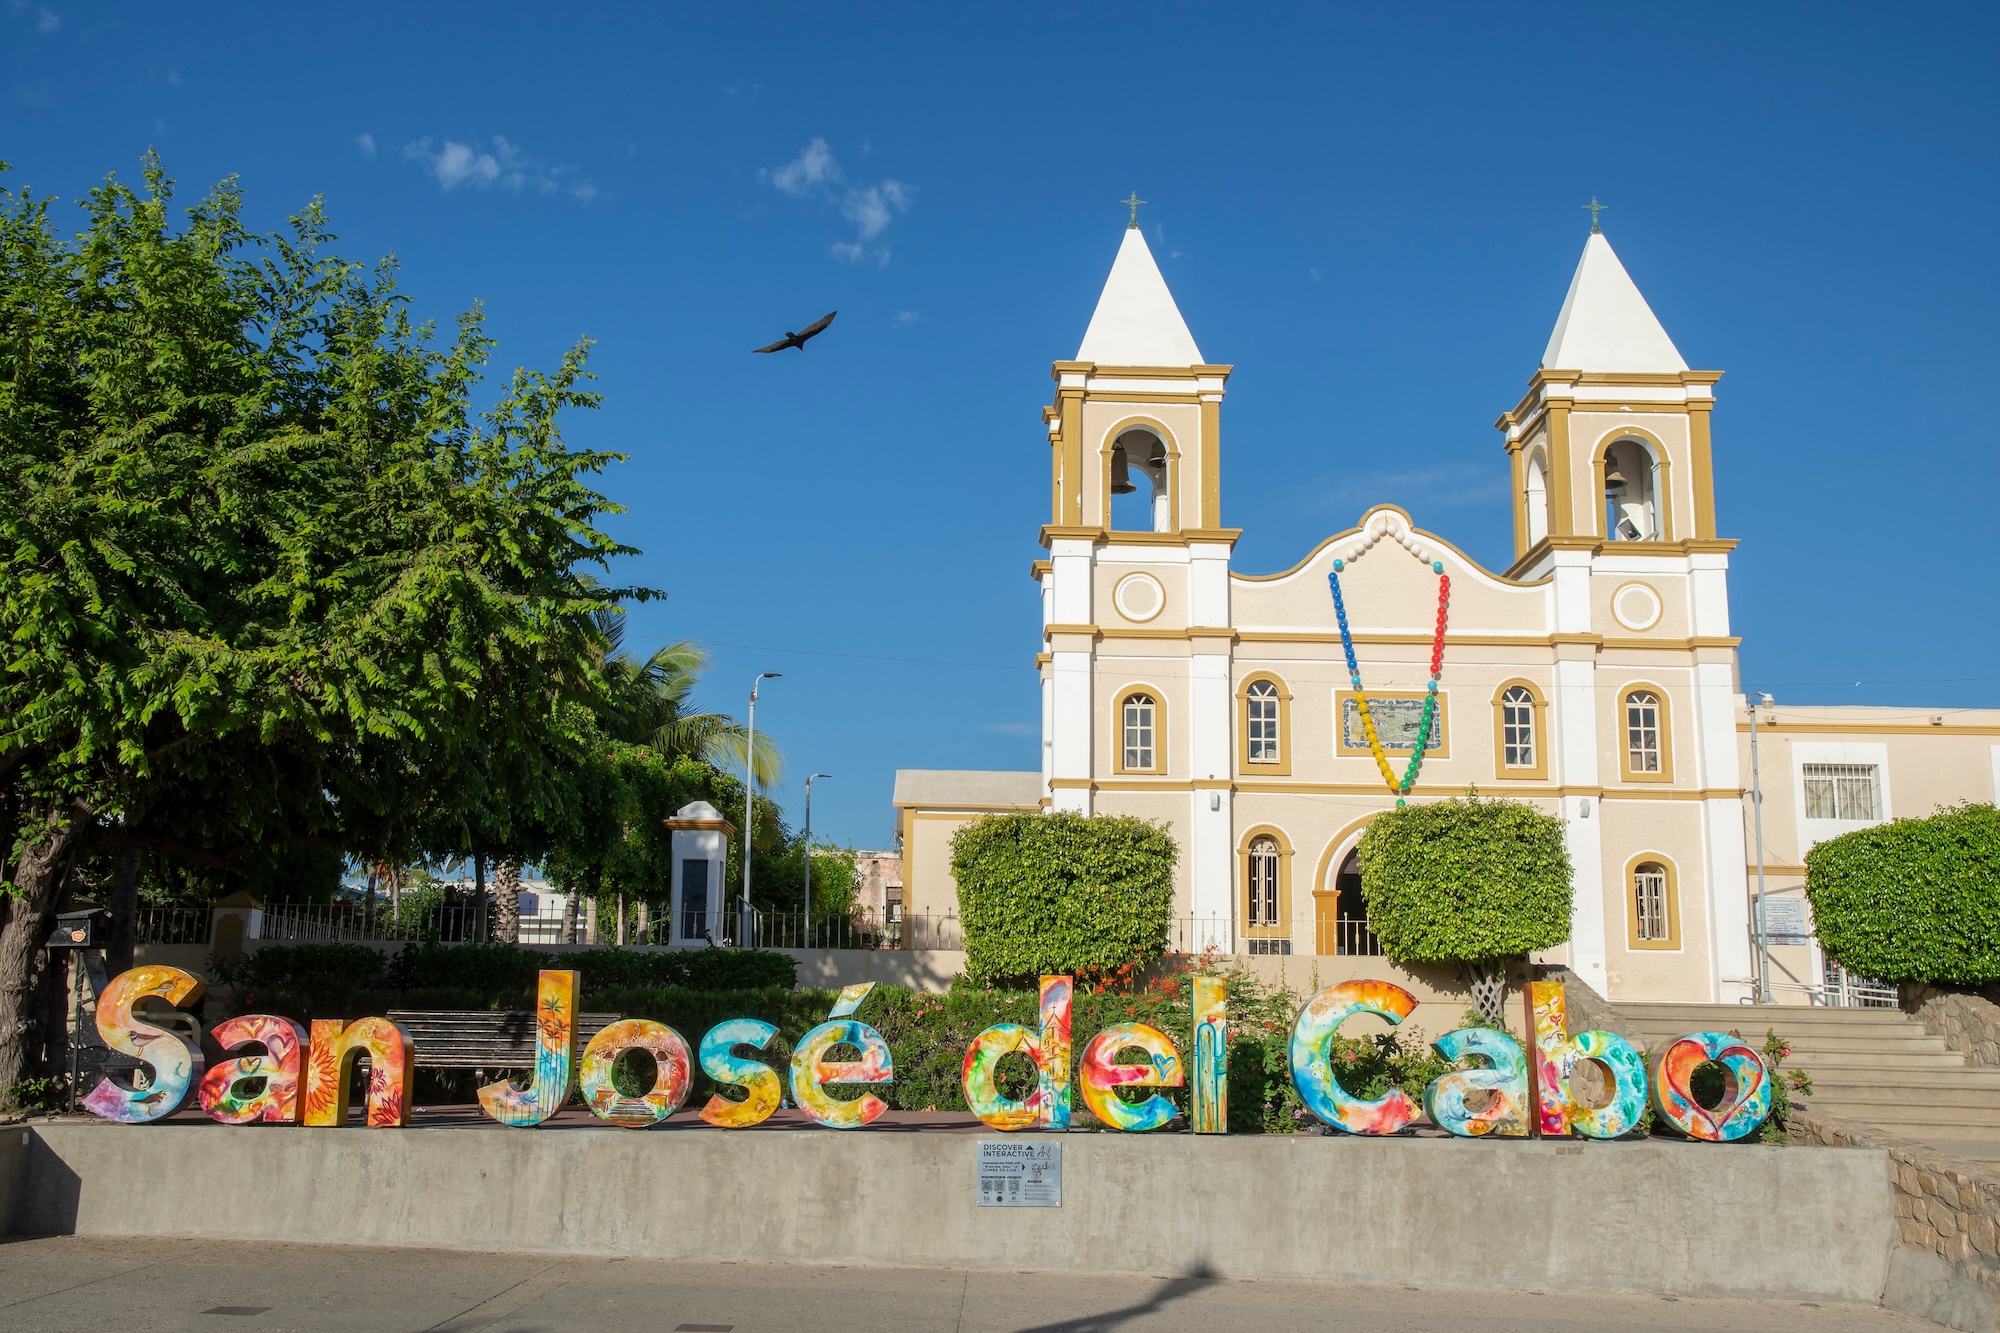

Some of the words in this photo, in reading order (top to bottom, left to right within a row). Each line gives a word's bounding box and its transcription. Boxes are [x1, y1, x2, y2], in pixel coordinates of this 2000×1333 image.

[82, 965, 412, 1127] San
[477, 970, 894, 1129] José
[962, 975, 1228, 1134] del
[1289, 979, 1772, 1142] Cabo
[1037, 1145, 1052, 1157] Art
